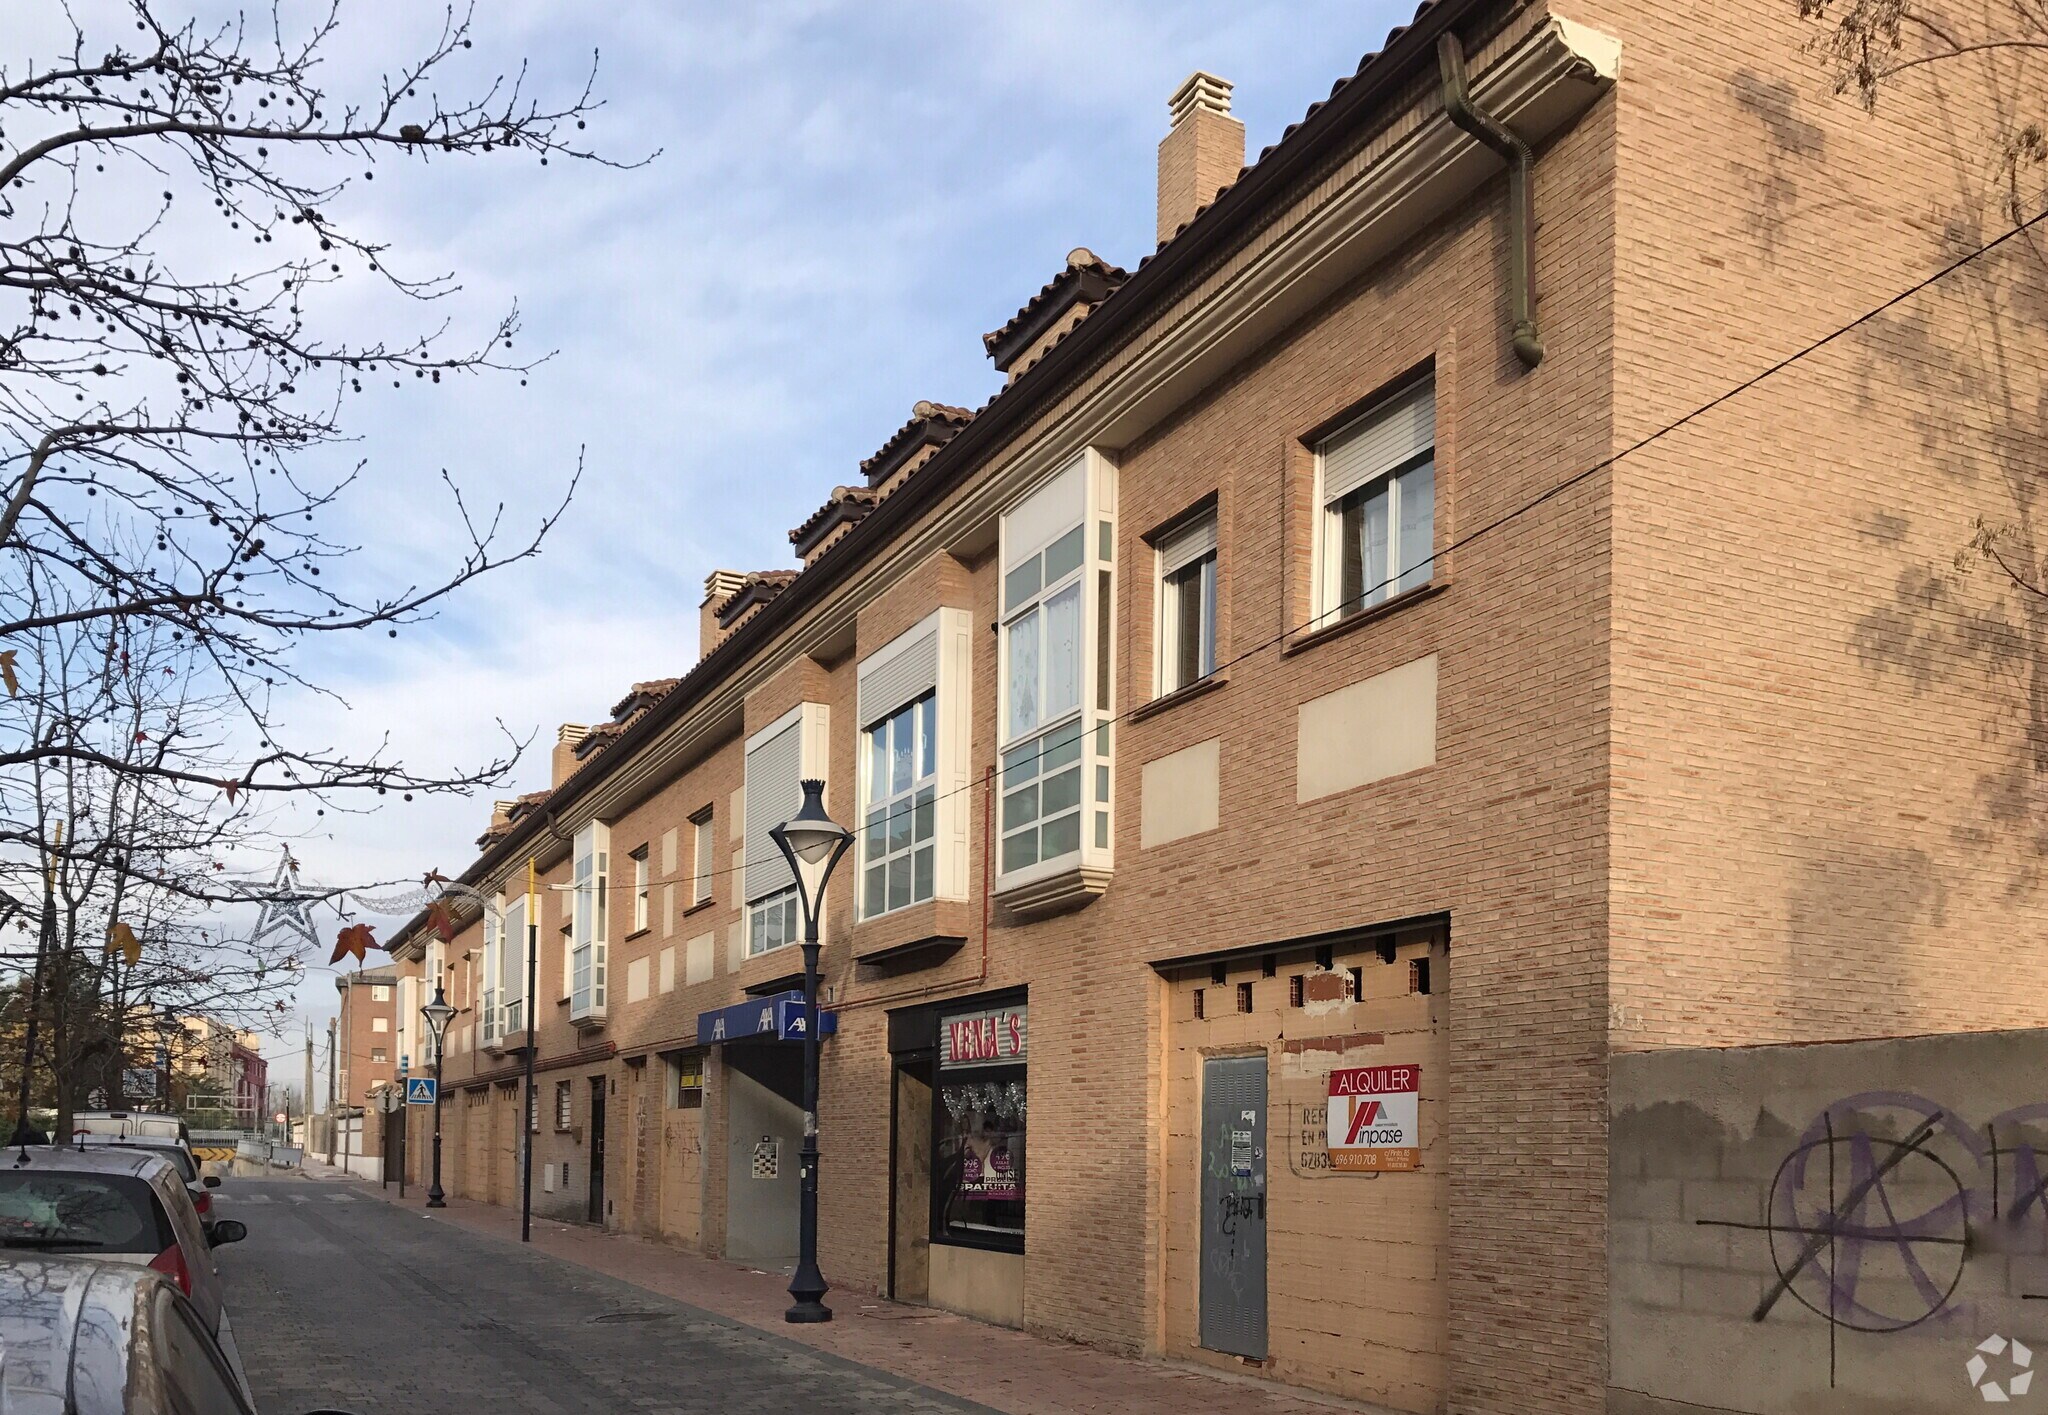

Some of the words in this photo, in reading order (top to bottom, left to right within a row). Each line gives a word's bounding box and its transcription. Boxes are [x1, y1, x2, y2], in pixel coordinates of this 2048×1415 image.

[787, 1017, 806, 1032] AX
[949, 1012, 1022, 1062] NENA'S
[1337, 1069, 1410, 1094] ALQUILER
[1302, 1130, 1314, 1146] EN
[1358, 1126, 1403, 1147] inpase
[1335, 1153, 1348, 1165] 696
[1349, 1153, 1362, 1165] 910
[1363, 1153, 1377, 1165] 708
